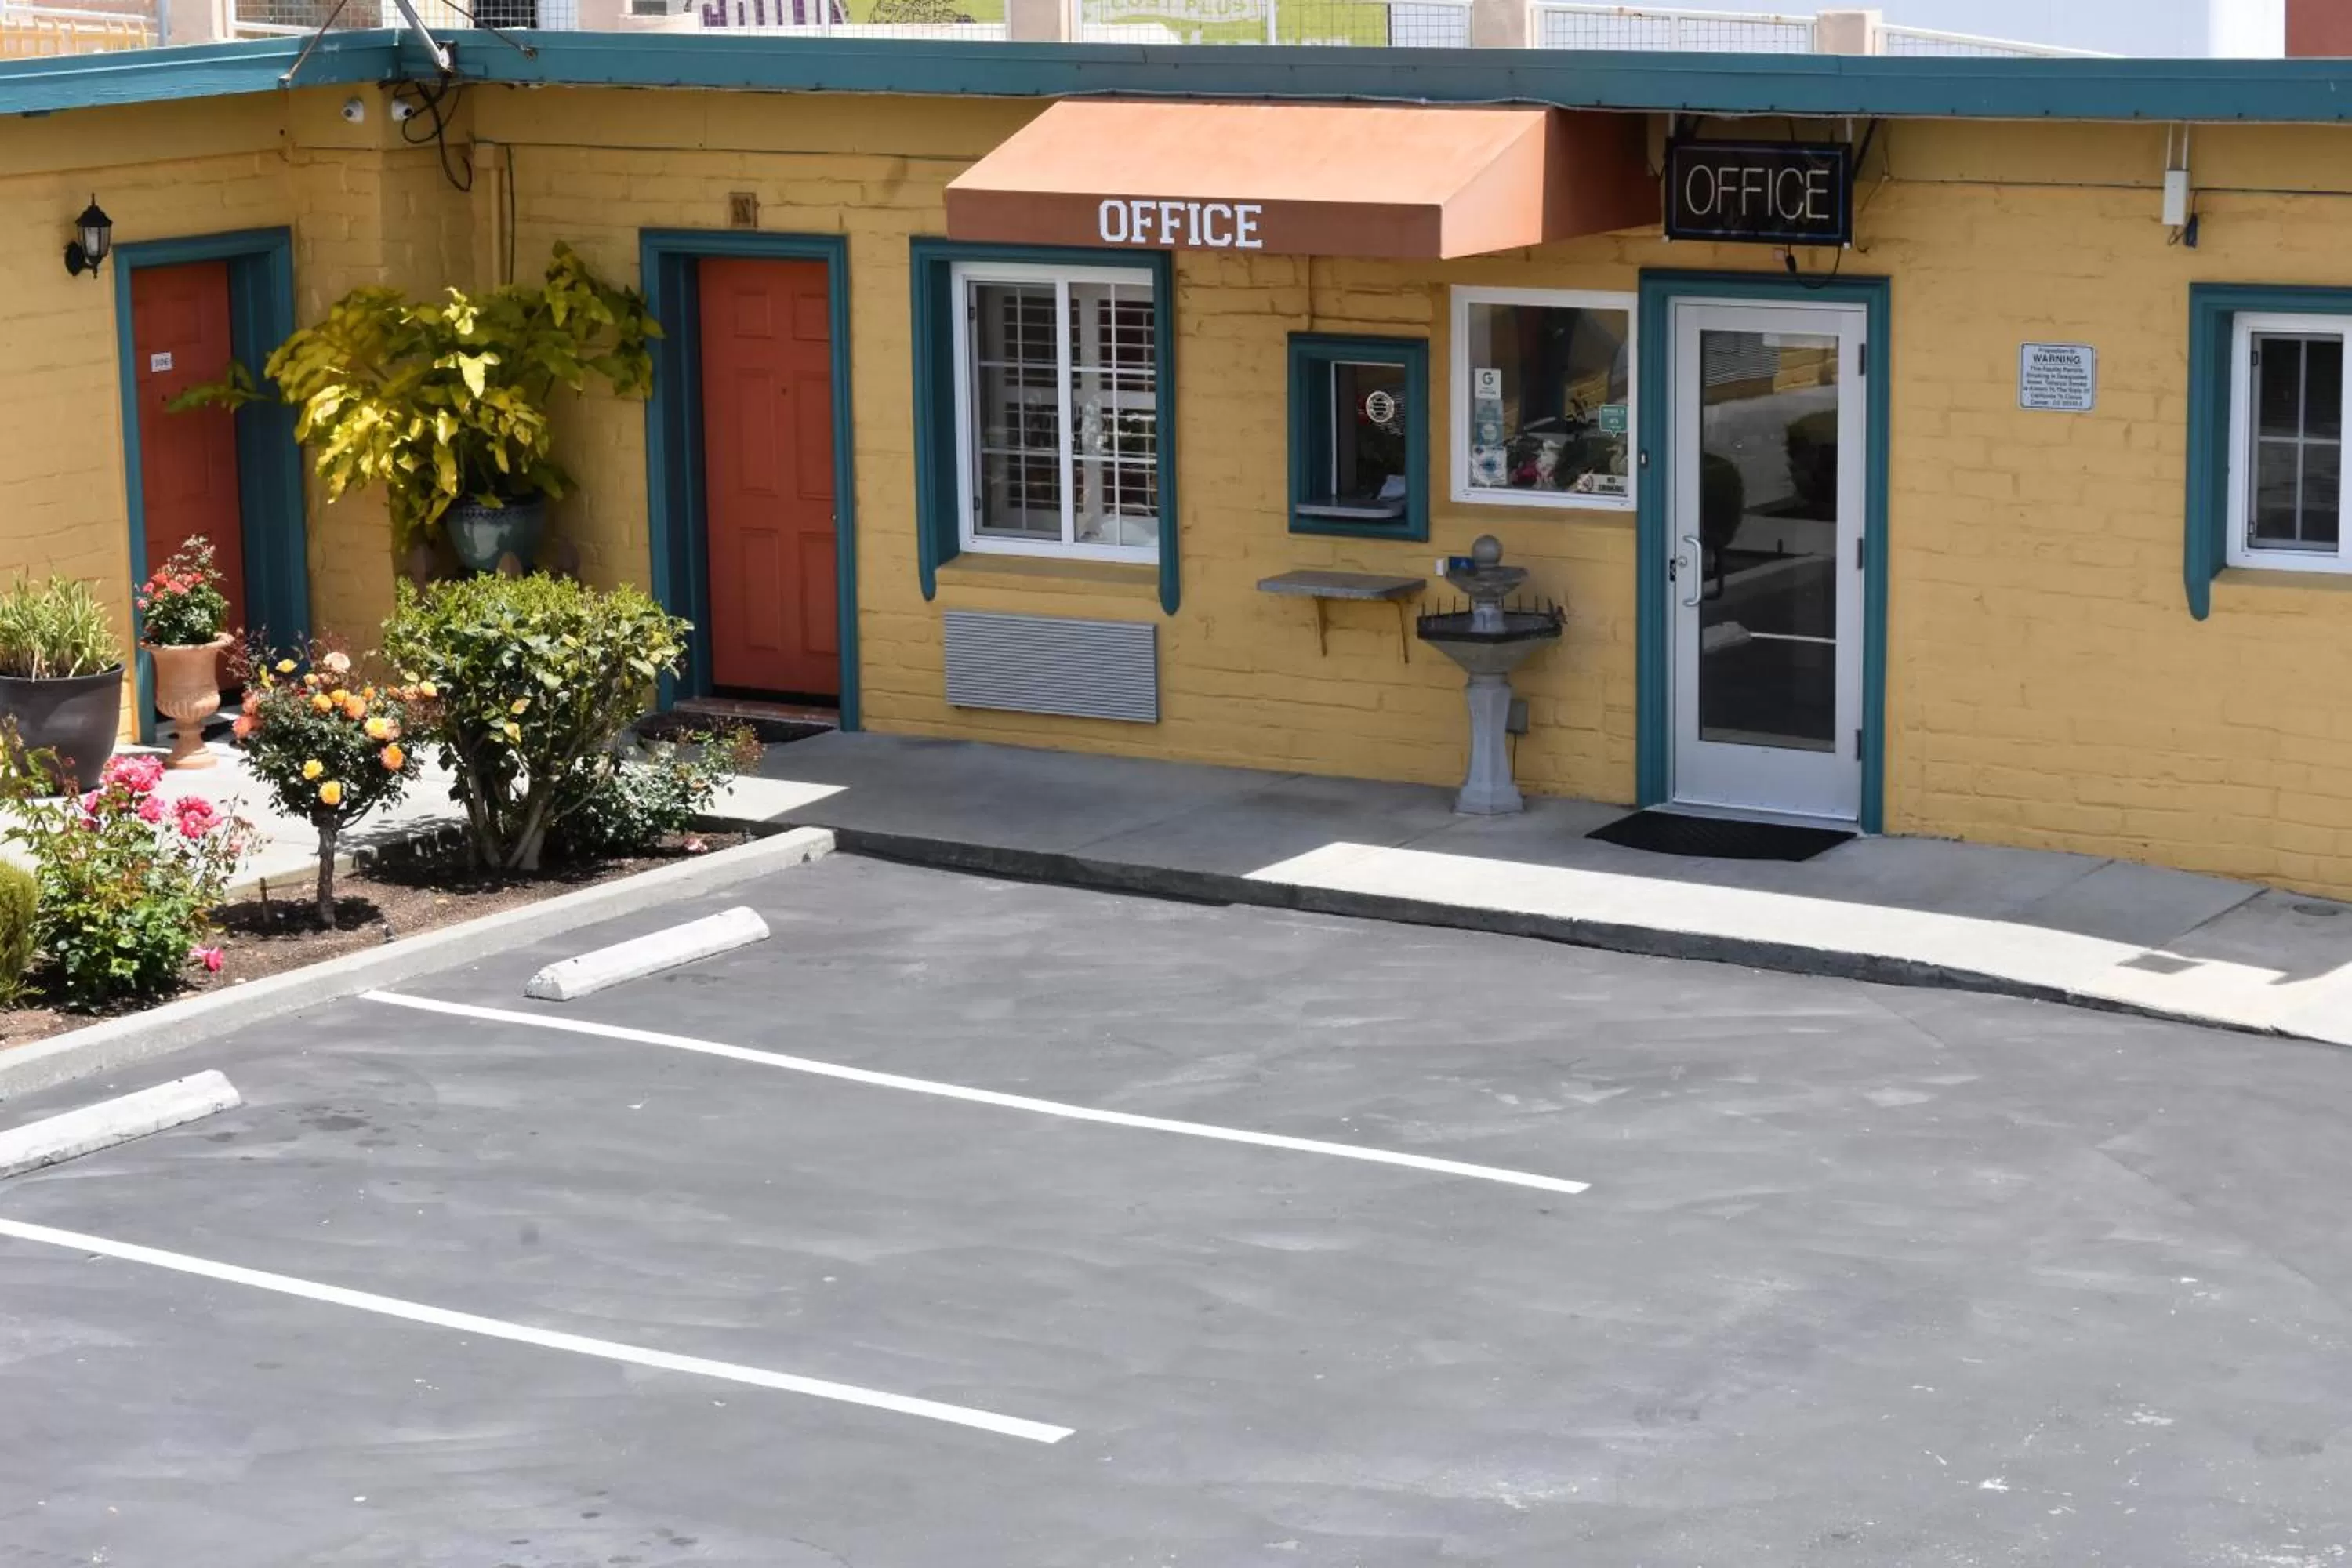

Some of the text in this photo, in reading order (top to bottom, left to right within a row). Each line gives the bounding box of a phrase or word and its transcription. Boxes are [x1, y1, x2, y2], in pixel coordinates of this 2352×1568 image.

[1686, 164, 1831, 220] OFFICE
[1098, 199, 1263, 249] OFFICE
[2033, 354, 2081, 365] WARNING
